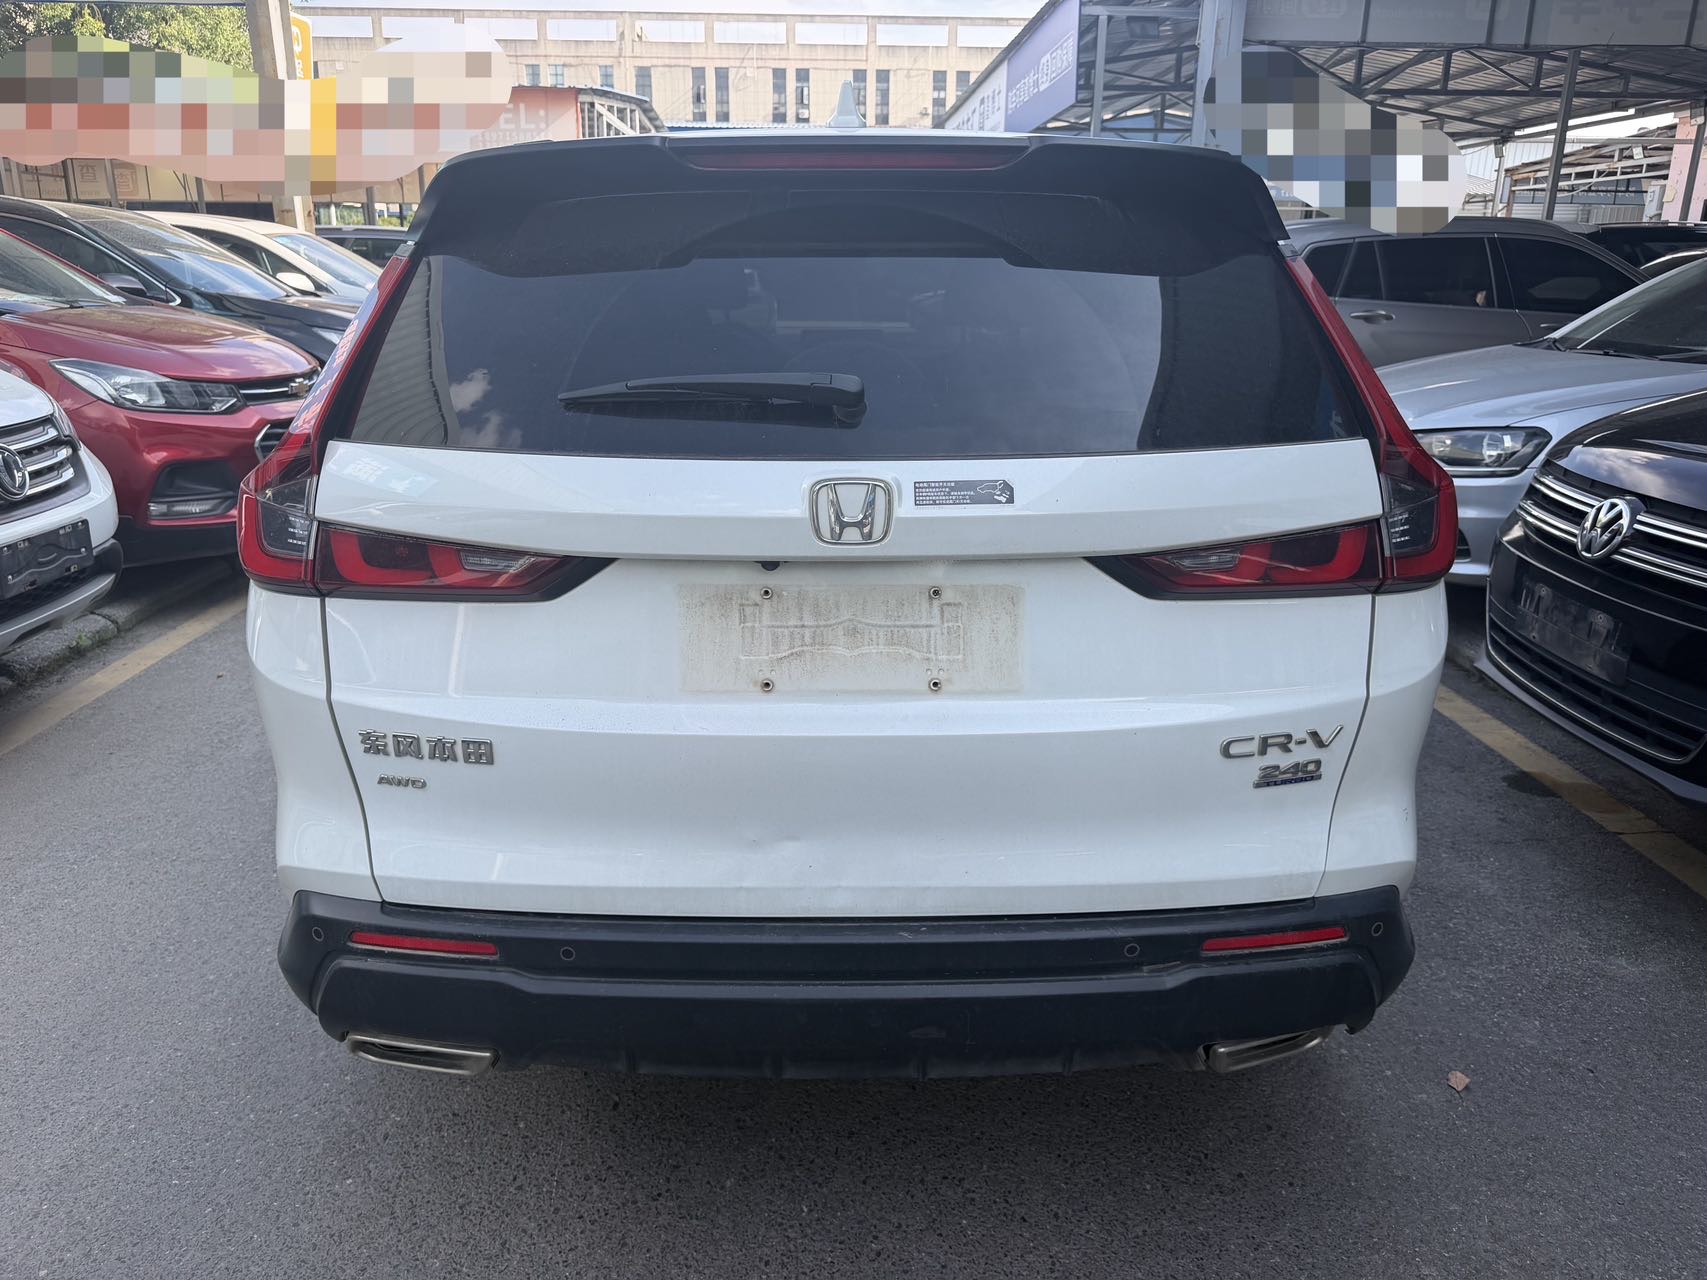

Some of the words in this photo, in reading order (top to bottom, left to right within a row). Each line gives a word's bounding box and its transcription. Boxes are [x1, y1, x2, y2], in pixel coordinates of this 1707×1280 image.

[500, 101, 546, 129] EL:
[358, 729, 495, 765] 东风本田
[1220, 724, 1344, 759] CR-V
[377, 774, 427, 789] AWD
[1258, 758, 1322, 780] 240
